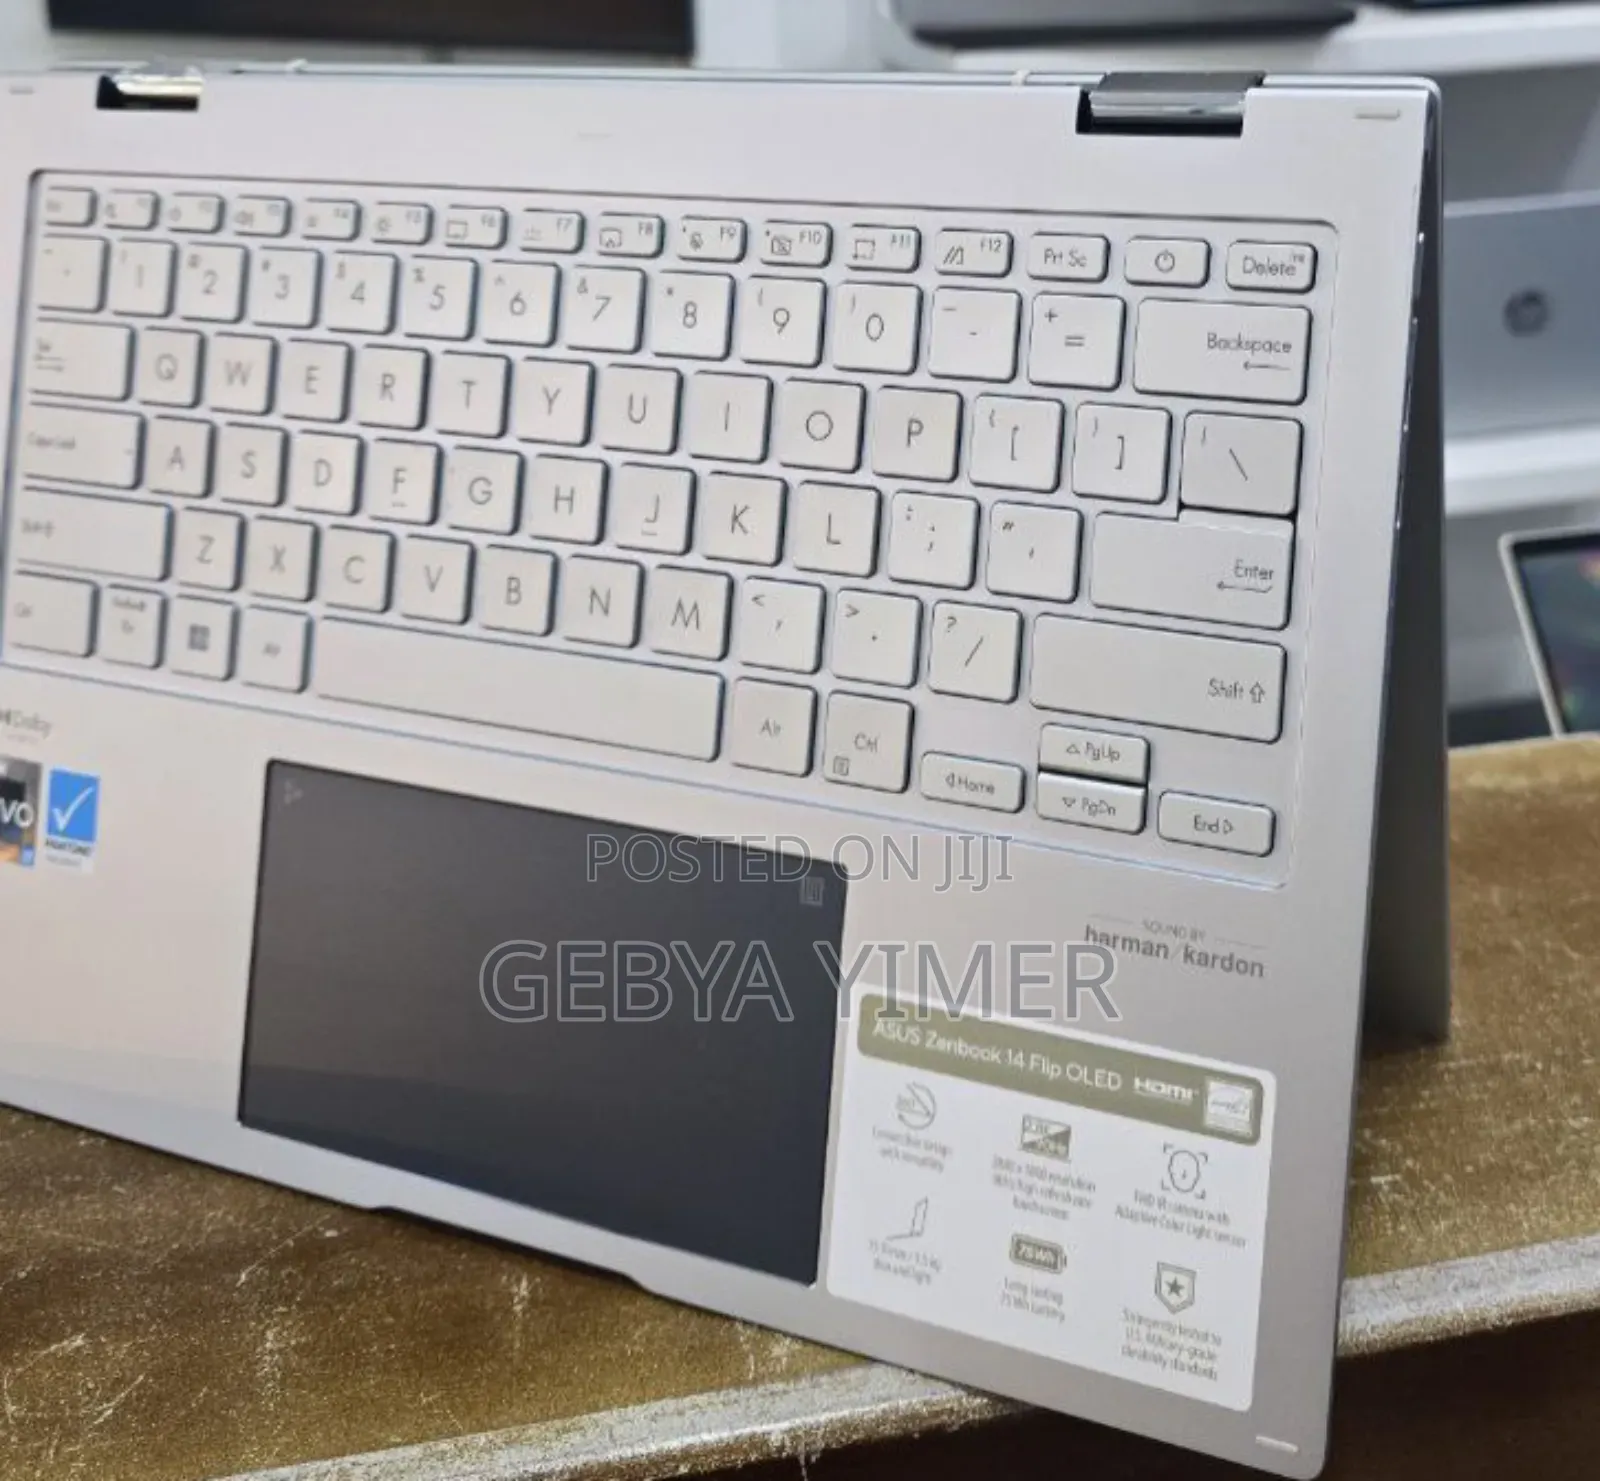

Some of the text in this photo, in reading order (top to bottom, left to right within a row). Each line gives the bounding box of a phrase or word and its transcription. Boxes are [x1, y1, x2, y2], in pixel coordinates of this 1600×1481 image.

[638, 221, 654, 236] F8
[719, 226, 737, 241] F9
[798, 229, 823, 246] F10
[890, 233, 911, 248] F11
[980, 238, 1003, 253] F12
[1242, 255, 1297, 277] Delete
[202, 268, 218, 296] 2
[274, 273, 291, 301] 3
[349, 281, 366, 303] 4
[429, 283, 446, 312] 5
[509, 291, 526, 316] 6
[592, 295, 613, 321] 7
[682, 300, 698, 329] 8
[772, 307, 791, 335] 9
[1207, 332, 1293, 356] Backspace
[155, 353, 178, 382] Q
[224, 360, 252, 387] W
[304, 364, 320, 395] E
[380, 372, 396, 401] R
[461, 379, 477, 408] T
[542, 386, 561, 416] Y
[627, 393, 648, 425] U
[804, 410, 834, 442] O
[906, 417, 925, 447] P
[167, 445, 185, 470] A
[240, 449, 257, 480] S
[313, 457, 333, 488] D
[392, 466, 407, 494] F
[467, 475, 493, 506] G
[553, 485, 575, 514] H
[644, 494, 661, 524] J
[730, 504, 750, 534] K
[825, 513, 842, 546] L
[195, 534, 215, 565] Z
[269, 545, 286, 573] X
[342, 554, 365, 585] C
[424, 565, 444, 593] V
[1233, 559, 1275, 581] Enter
[505, 575, 522, 606] B
[589, 587, 611, 617] N
[671, 598, 700, 631] M
[1207, 677, 1244, 699] Shift
[1084, 741, 1121, 763] PgUp
[957, 775, 996, 795] Home
[1081, 797, 1117, 817] PgDn
[1193, 814, 1220, 834] End
[872, 1018, 921, 1048] ASUS
[925, 1033, 1001, 1065] Zenbook
[1005, 1049, 1026, 1069] 14
[1029, 1052, 1062, 1079] Flip
[1066, 1062, 1123, 1091] OLED
